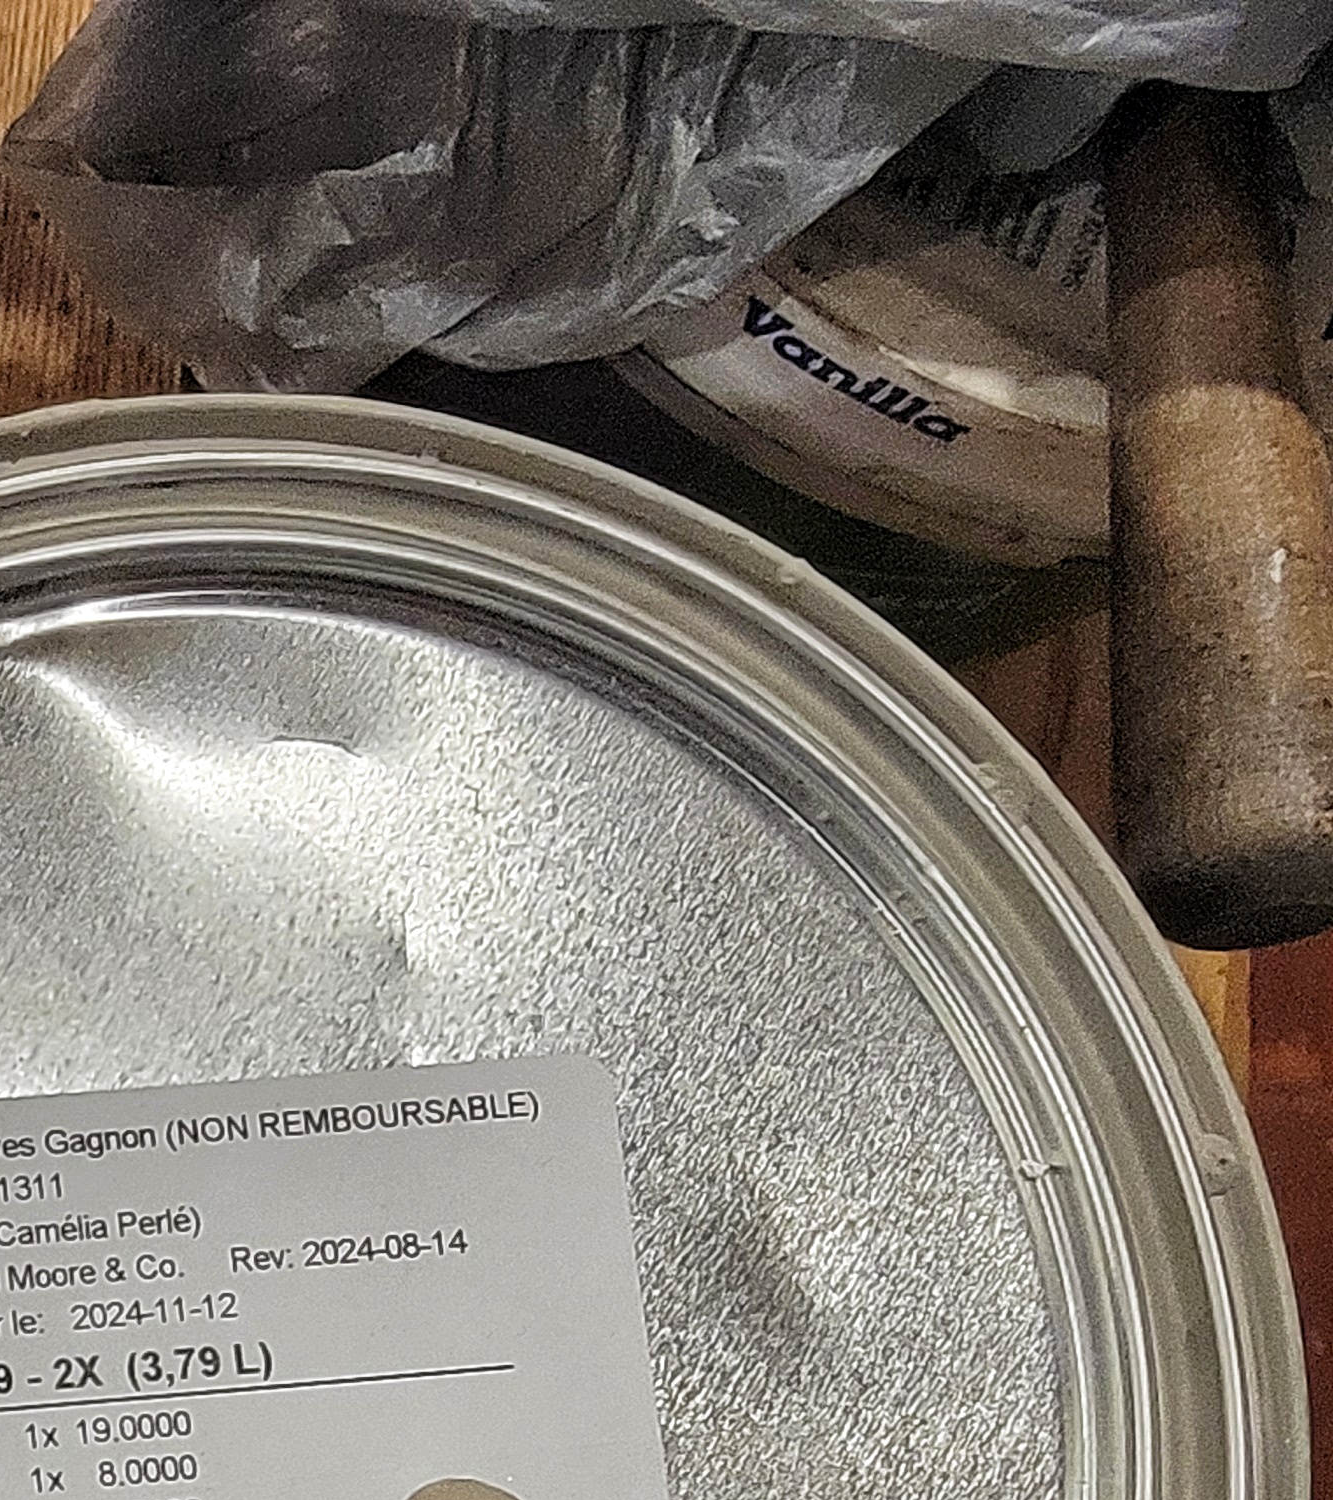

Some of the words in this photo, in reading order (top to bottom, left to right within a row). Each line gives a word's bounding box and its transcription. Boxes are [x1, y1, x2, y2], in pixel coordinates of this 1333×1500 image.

[742, 297, 971, 443] Vanilla
[44, 1128, 157, 1159] Gagnon
[166, 1114, 249, 1152] (NON
[258, 1091, 539, 1138] REMBOURSABLE)
[117, 1205, 201, 1239] Perlé)
[7, 1263, 97, 1291] Moore
[104, 1257, 127, 1283] &
[136, 1254, 185, 1280] Co.
[230, 1246, 294, 1273] Rev:
[301, 1228, 469, 1268] 2024-08-14
[11, 1309, 45, 1336] le:
[70, 1292, 239, 1331] 2024-11-12
[52, 1354, 104, 1391] 2X
[127, 1346, 221, 1392] (3,79
[233, 1341, 273, 1382] L)
[25, 1423, 59, 1450] 1x
[76, 1410, 192, 1445] 19.0000
[30, 1467, 65, 1493] 1x
[98, 1454, 198, 1487] 8.0000
